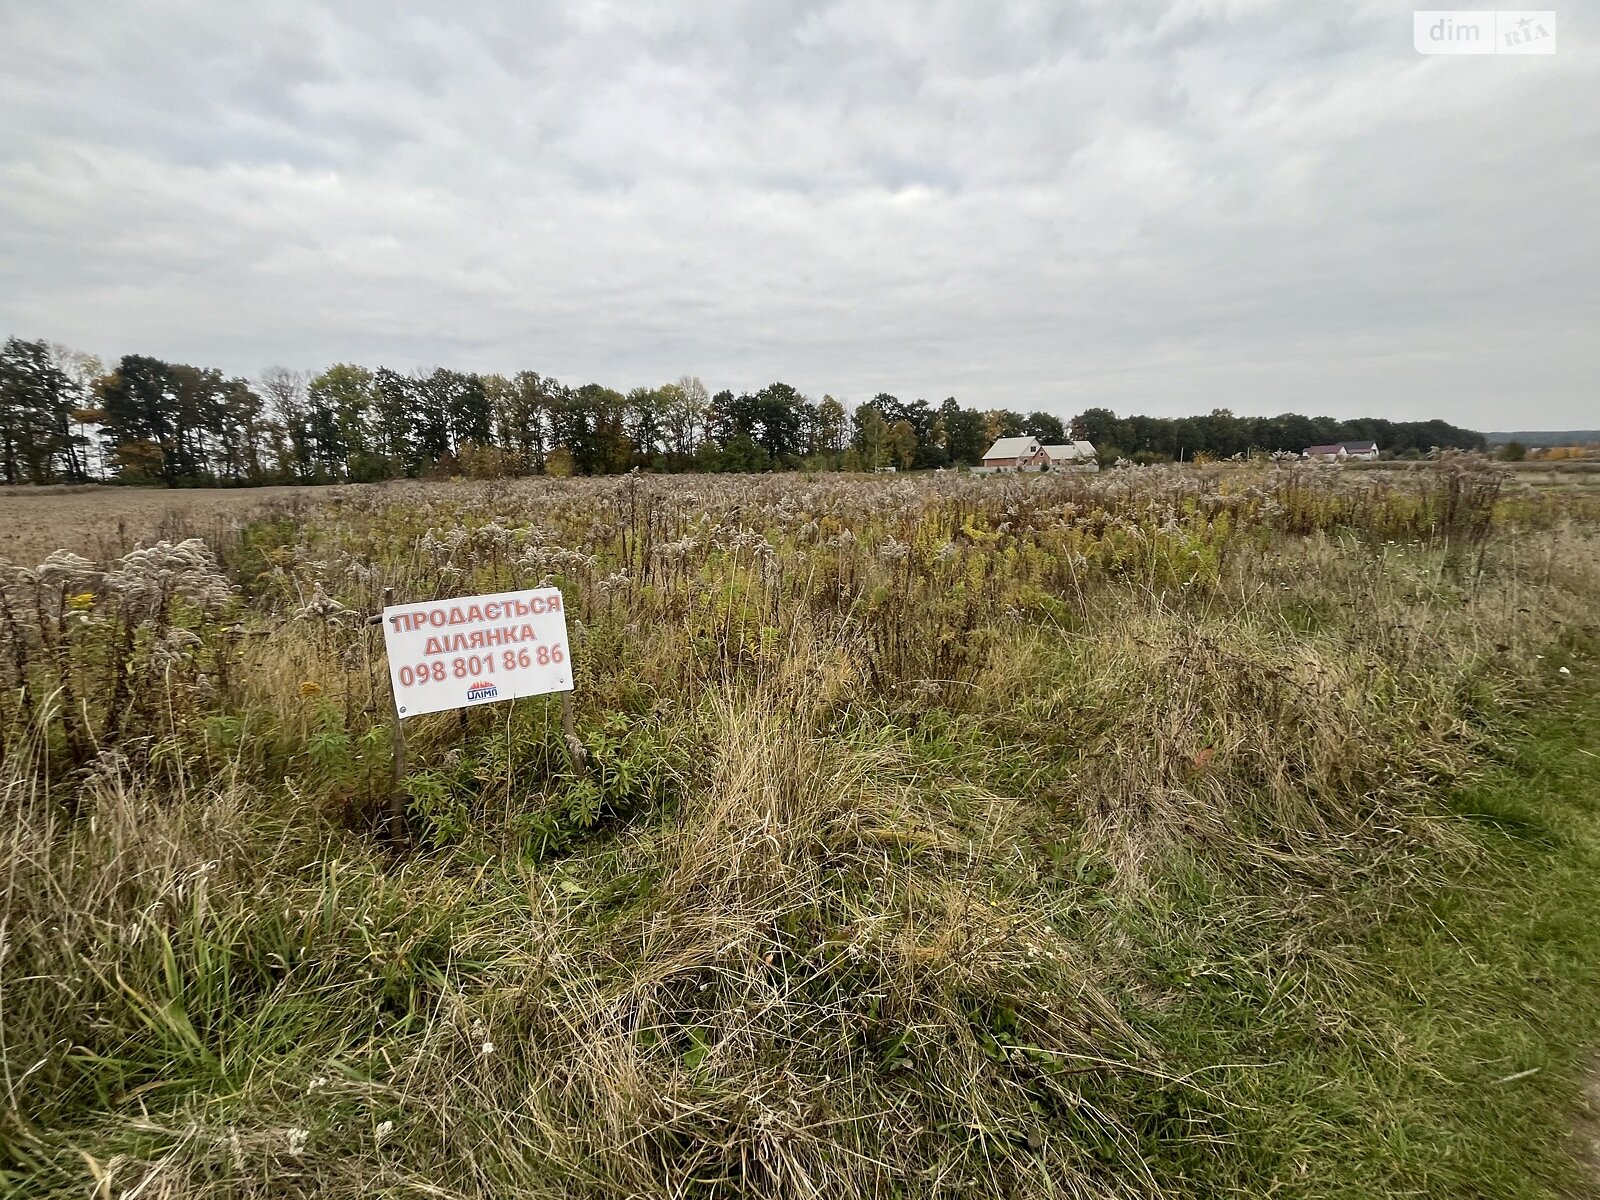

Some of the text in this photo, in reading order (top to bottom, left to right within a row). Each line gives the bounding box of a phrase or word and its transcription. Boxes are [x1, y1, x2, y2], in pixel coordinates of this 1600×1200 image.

[393, 594, 562, 633] ПРОДАЄТЬСЯ
[424, 623, 537, 656] ДІЛЯНКА
[399, 642, 564, 688] 098 801 86 86
